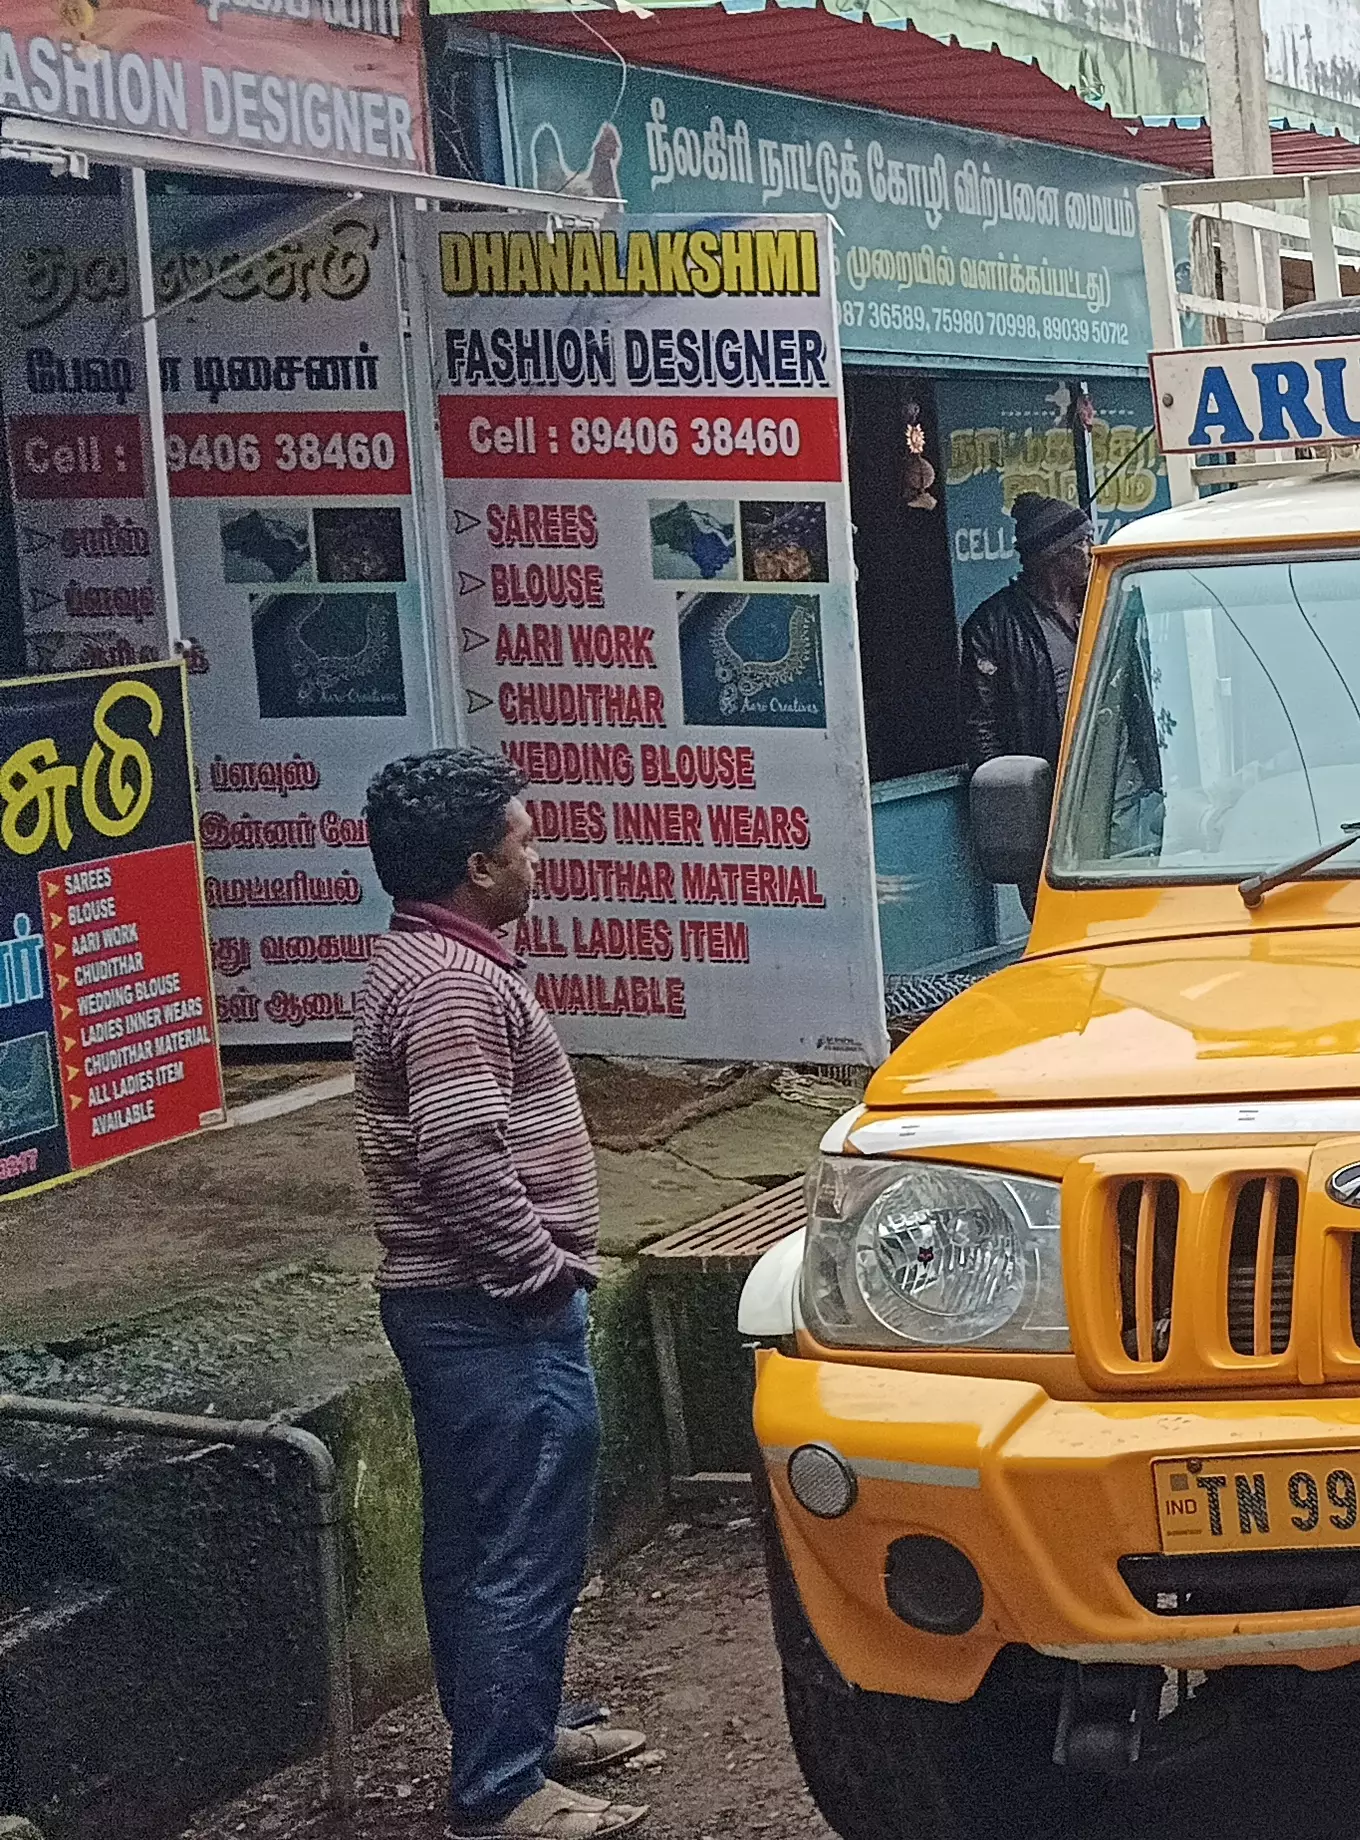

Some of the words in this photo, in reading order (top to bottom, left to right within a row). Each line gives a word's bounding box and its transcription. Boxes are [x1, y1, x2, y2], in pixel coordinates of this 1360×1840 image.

[201, 66, 416, 162] DESIGNER
[646, 97, 753, 192] நீலகிரி
[759, 138, 862, 210] நாட்டுக்
[867, 140, 950, 231] கோழி
[954, 158, 1059, 232] விற்பனை
[1064, 186, 1136, 238] மையம்
[440, 230, 820, 298] DHANALAKSHMI
[847, 245, 955, 292] முறையில்
[868, 302, 931, 332] 36589,
[932, 307, 984, 335] 75980
[988, 311, 1041, 341] 70998,
[1043, 318, 1089, 341] 89039
[1092, 321, 1129, 345] 50712
[445, 328, 614, 386] FASHION
[624, 328, 830, 388] DESIGNER
[24, 435, 102, 475] Cell
[275, 432, 396, 473] 38460
[468, 416, 536, 455] Cell
[570, 416, 679, 456] 89406
[691, 416, 800, 458] 38460
[486, 504, 598, 548] SAREES
[490, 563, 605, 608] BLOUSE
[494, 623, 563, 667] AARI
[568, 624, 658, 668] WORK
[499, 682, 667, 728] CHUDITHAR
[502, 740, 635, 786] WEDDING
[640, 745, 756, 789] BLOUSE
[526, 799, 605, 843] ADIES
[613, 802, 702, 846] INNER
[707, 805, 810, 848] WEARS
[64, 867, 113, 896] SAREES
[532, 858, 676, 903] HUDITHAR
[682, 862, 826, 908] MATERIAL
[67, 896, 116, 927] BLOUSE
[103, 922, 139, 951] WORK
[514, 915, 568, 957] ALL
[572, 917, 673, 961] LADIES
[679, 919, 750, 964] ITEM
[74, 951, 144, 987] CHUDITHAR
[77, 984, 134, 1017] WEDDING
[135, 972, 181, 1001] BLOUSE
[533, 974, 686, 1019] AVAILABLE
[80, 1014, 125, 1047] LADIES
[125, 1006, 163, 1035] INNER
[164, 995, 204, 1025] WEARS
[84, 1039, 154, 1078] CHUDITHAR
[154, 1024, 212, 1057] MATERIAL
[88, 1085, 113, 1108] ALL
[113, 1070, 155, 1101] LADIES
[156, 1060, 185, 1085] ITEM
[91, 1098, 156, 1138] AVAILABLE
[1165, 1498, 1198, 1516] IND
[1195, 1470, 1271, 1537] TN
